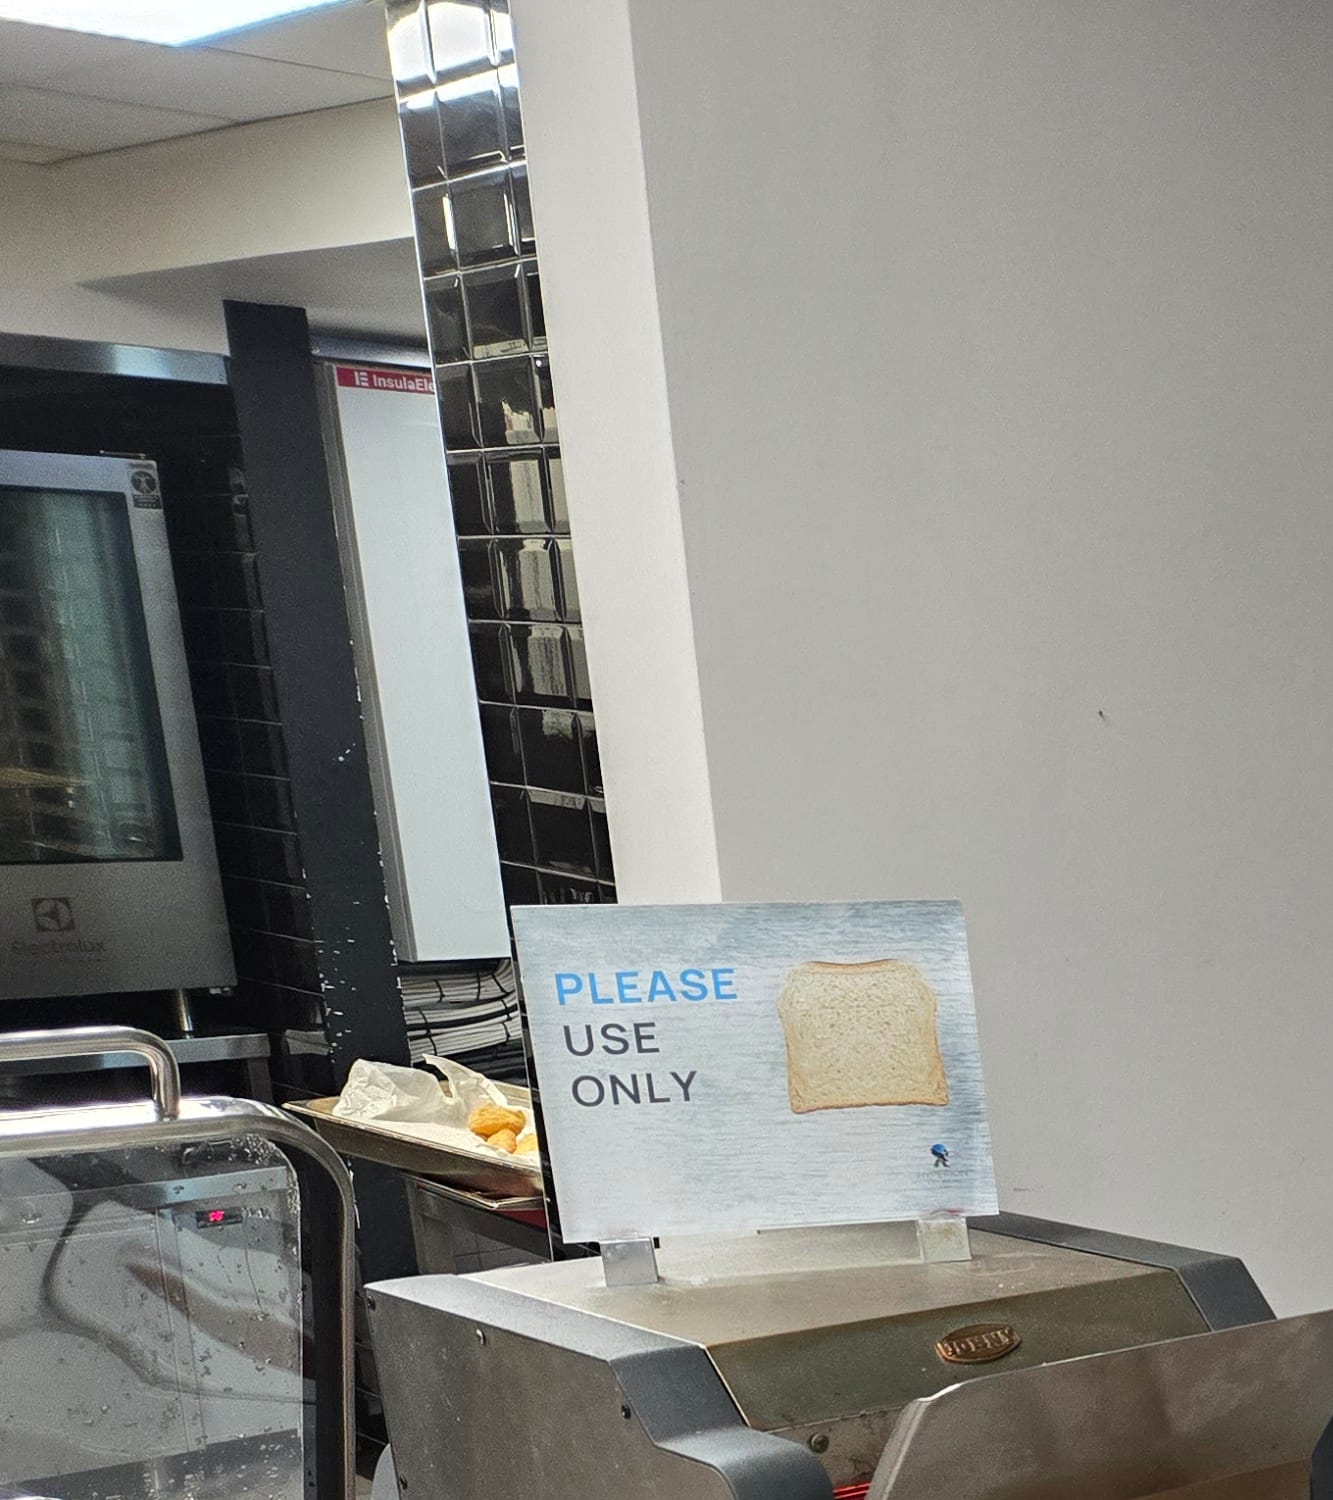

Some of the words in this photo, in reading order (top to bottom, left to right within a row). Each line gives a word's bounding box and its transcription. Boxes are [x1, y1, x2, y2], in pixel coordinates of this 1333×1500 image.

[554, 967, 738, 1006] PLEASE
[563, 1021, 661, 1057] USE
[571, 1070, 698, 1108] ONLY
